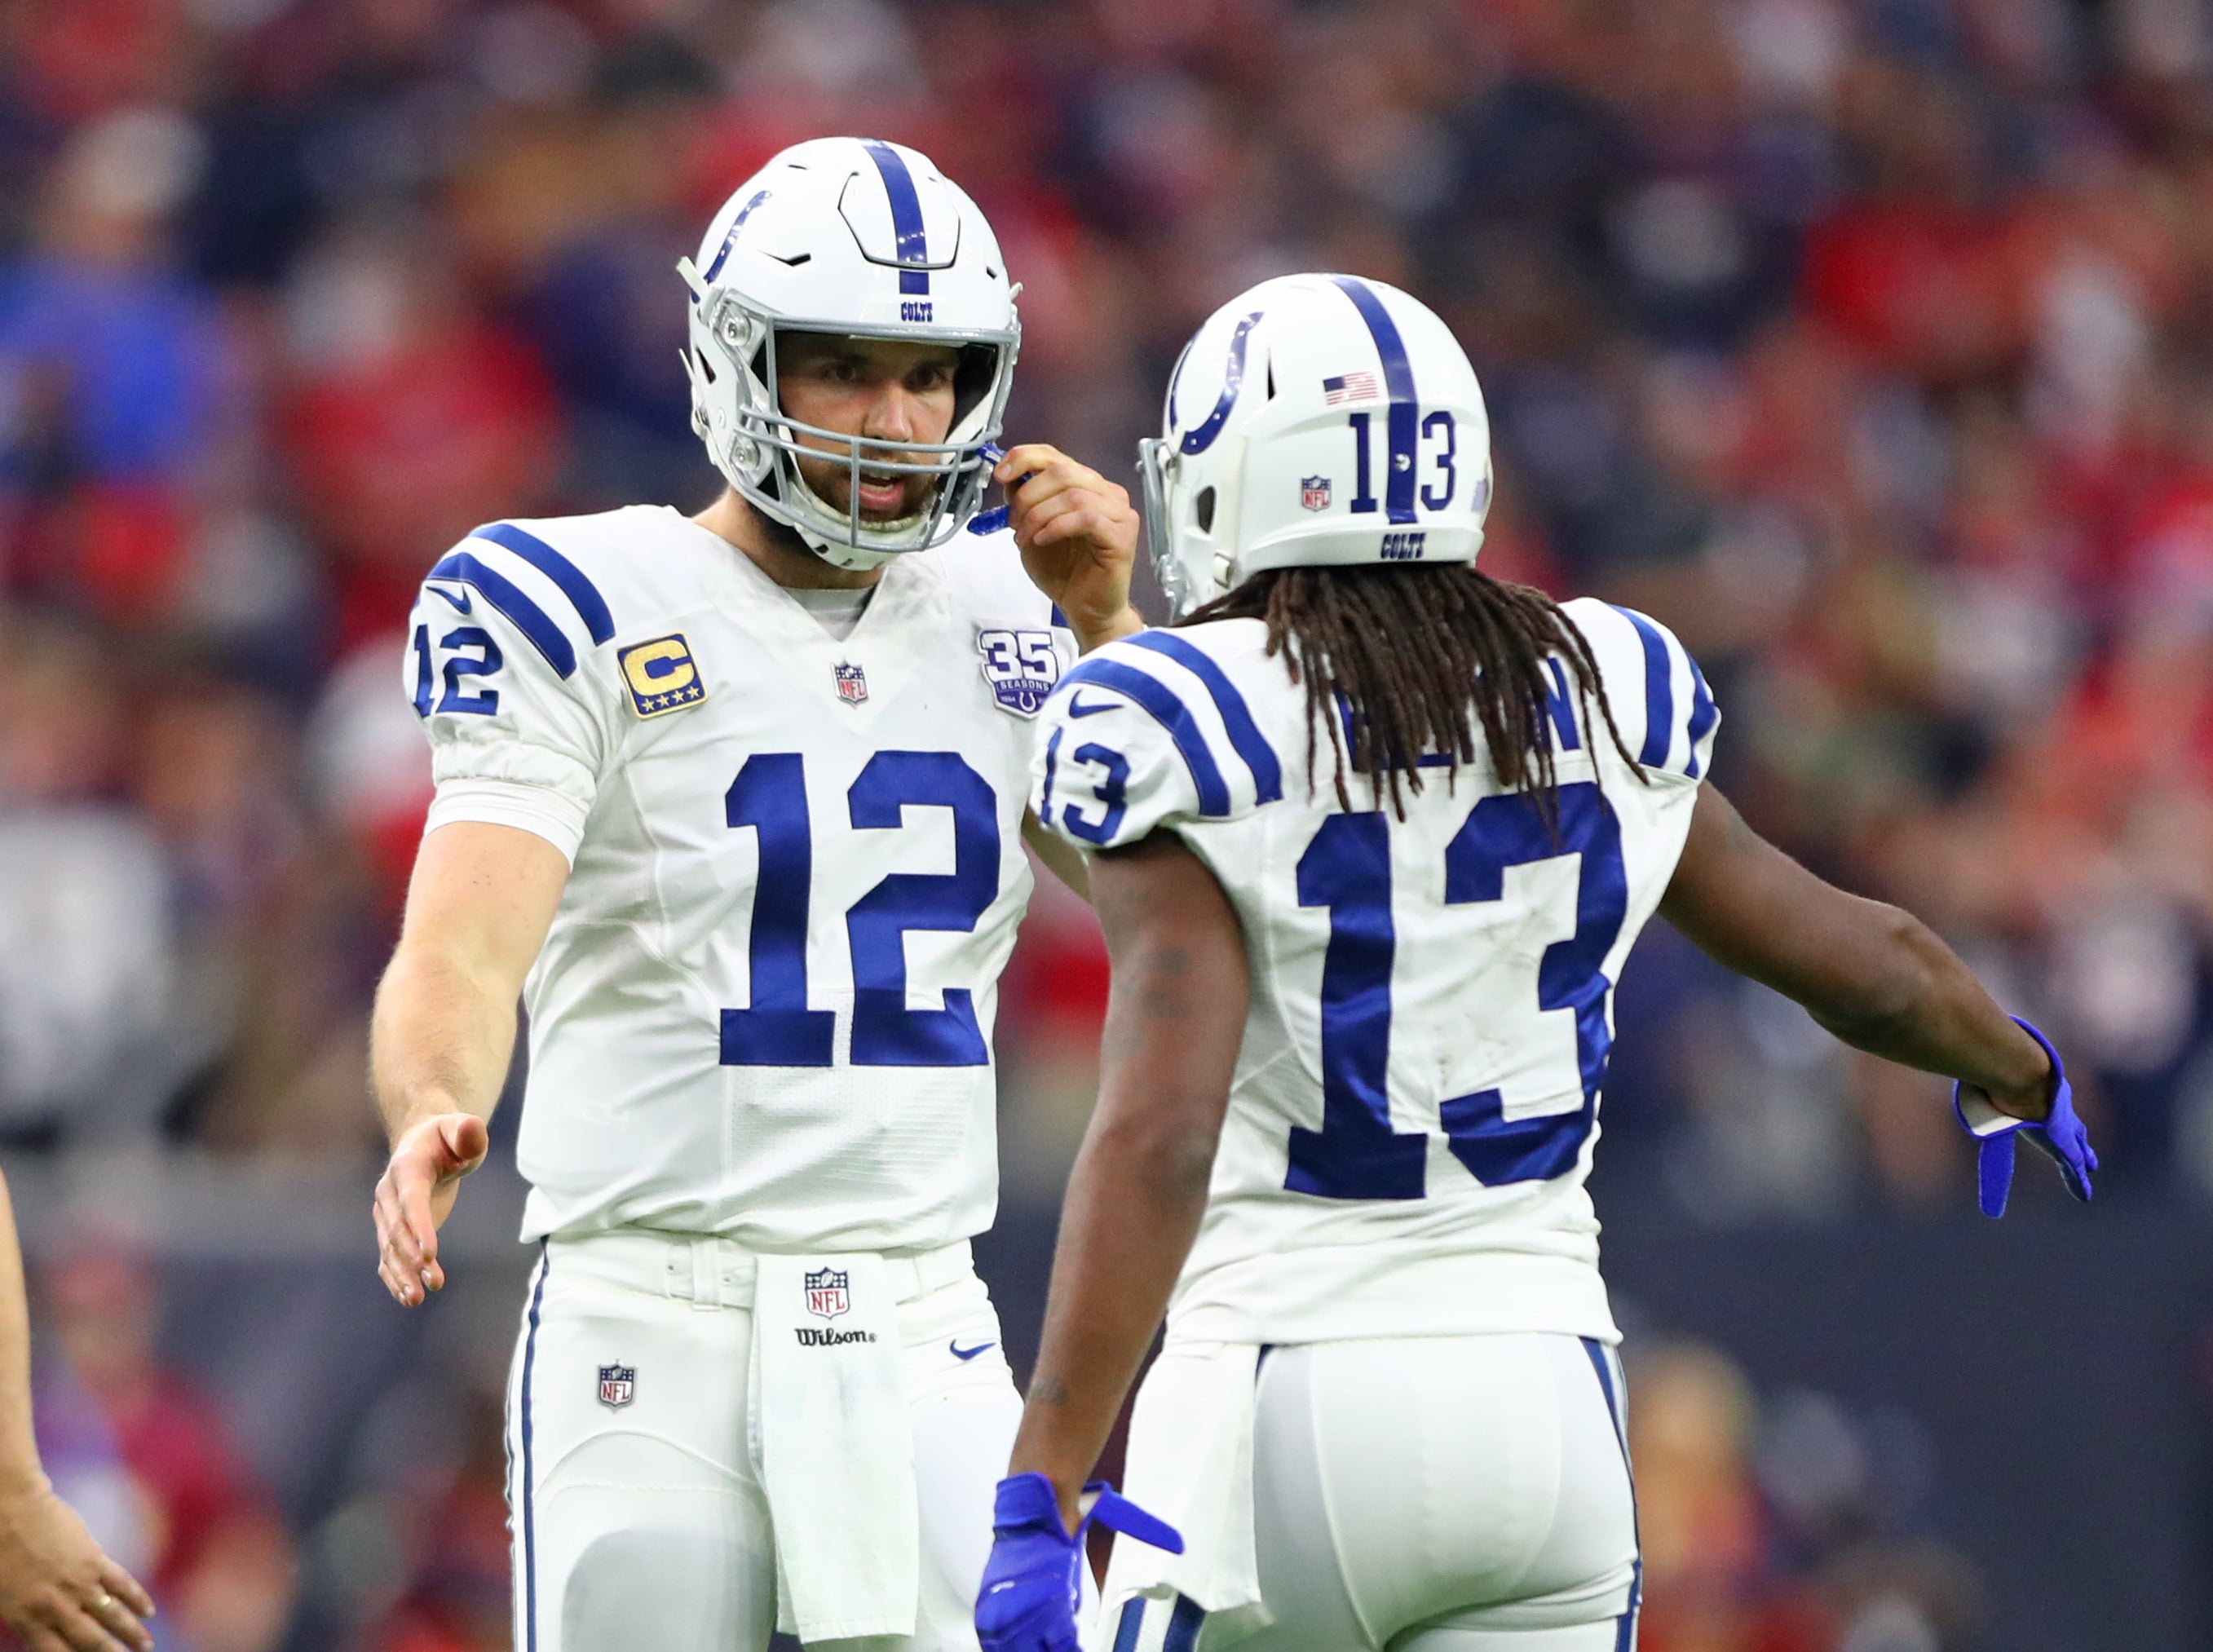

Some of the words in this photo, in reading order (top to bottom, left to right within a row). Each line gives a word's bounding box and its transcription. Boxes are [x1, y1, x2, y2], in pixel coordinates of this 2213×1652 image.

[900, 301, 933, 322] COLTS
[1349, 410, 1455, 514] 13
[1305, 491, 1329, 506] NFL
[1380, 532, 1425, 559] COLTS
[413, 625, 502, 718] 12
[624, 639, 695, 697] C
[979, 630, 1059, 685] 35
[841, 680, 865, 699] NFL
[1000, 679, 1050, 691] SEASONS
[1040, 727, 1131, 845] 13
[719, 750, 1000, 1067] 12
[1284, 781, 1628, 1200] 13
[811, 1290, 846, 1314] NFL
[603, 1382, 629, 1402] NFL
